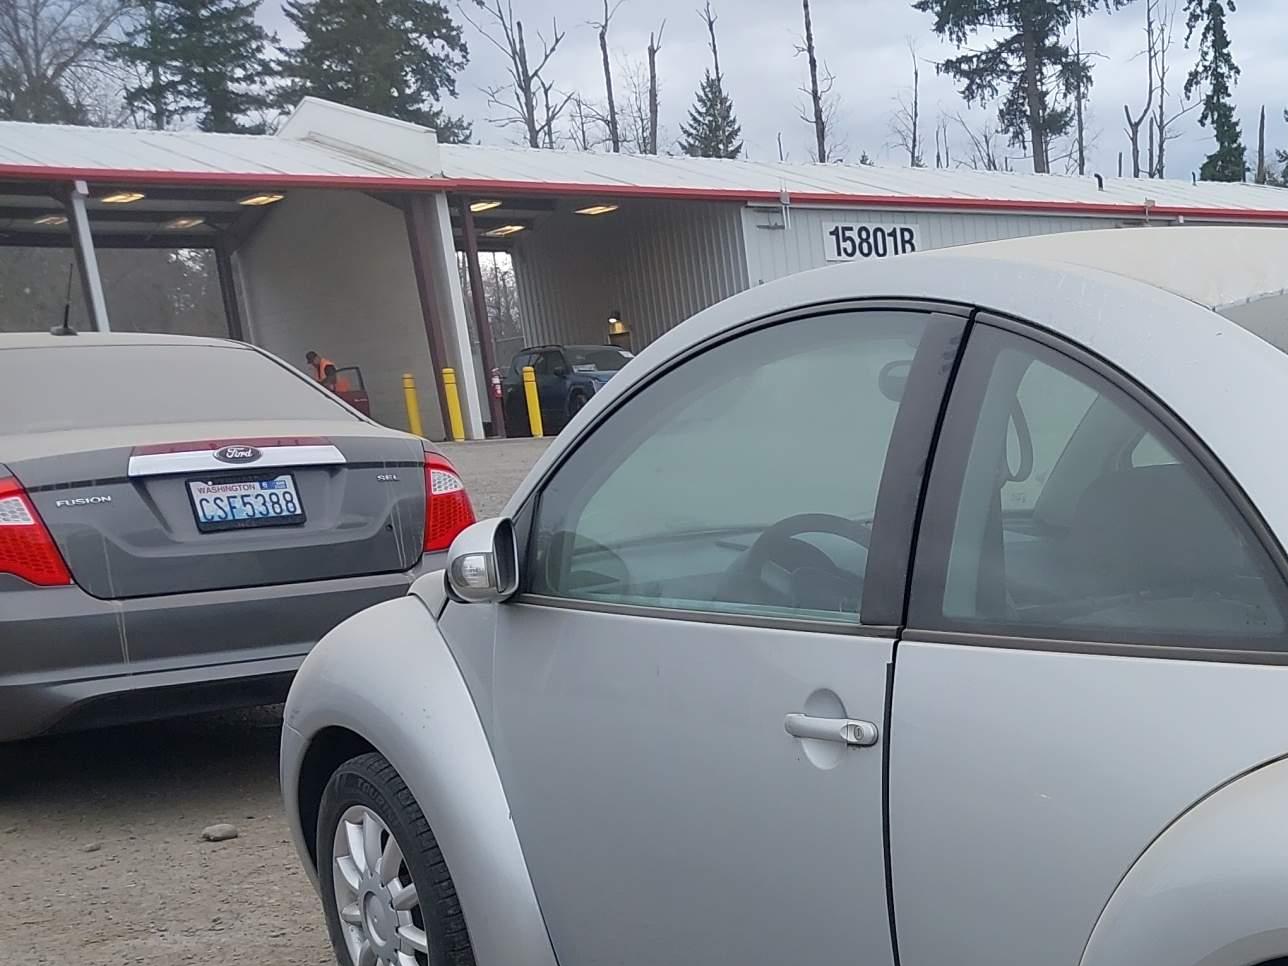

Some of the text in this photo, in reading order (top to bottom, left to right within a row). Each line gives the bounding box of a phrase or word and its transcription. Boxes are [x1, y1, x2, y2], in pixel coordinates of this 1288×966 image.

[225, 447, 253, 459] Ford
[377, 473, 400, 482] SEL
[197, 484, 256, 494] WASHINGTON
[55, 495, 112, 508] FUSION
